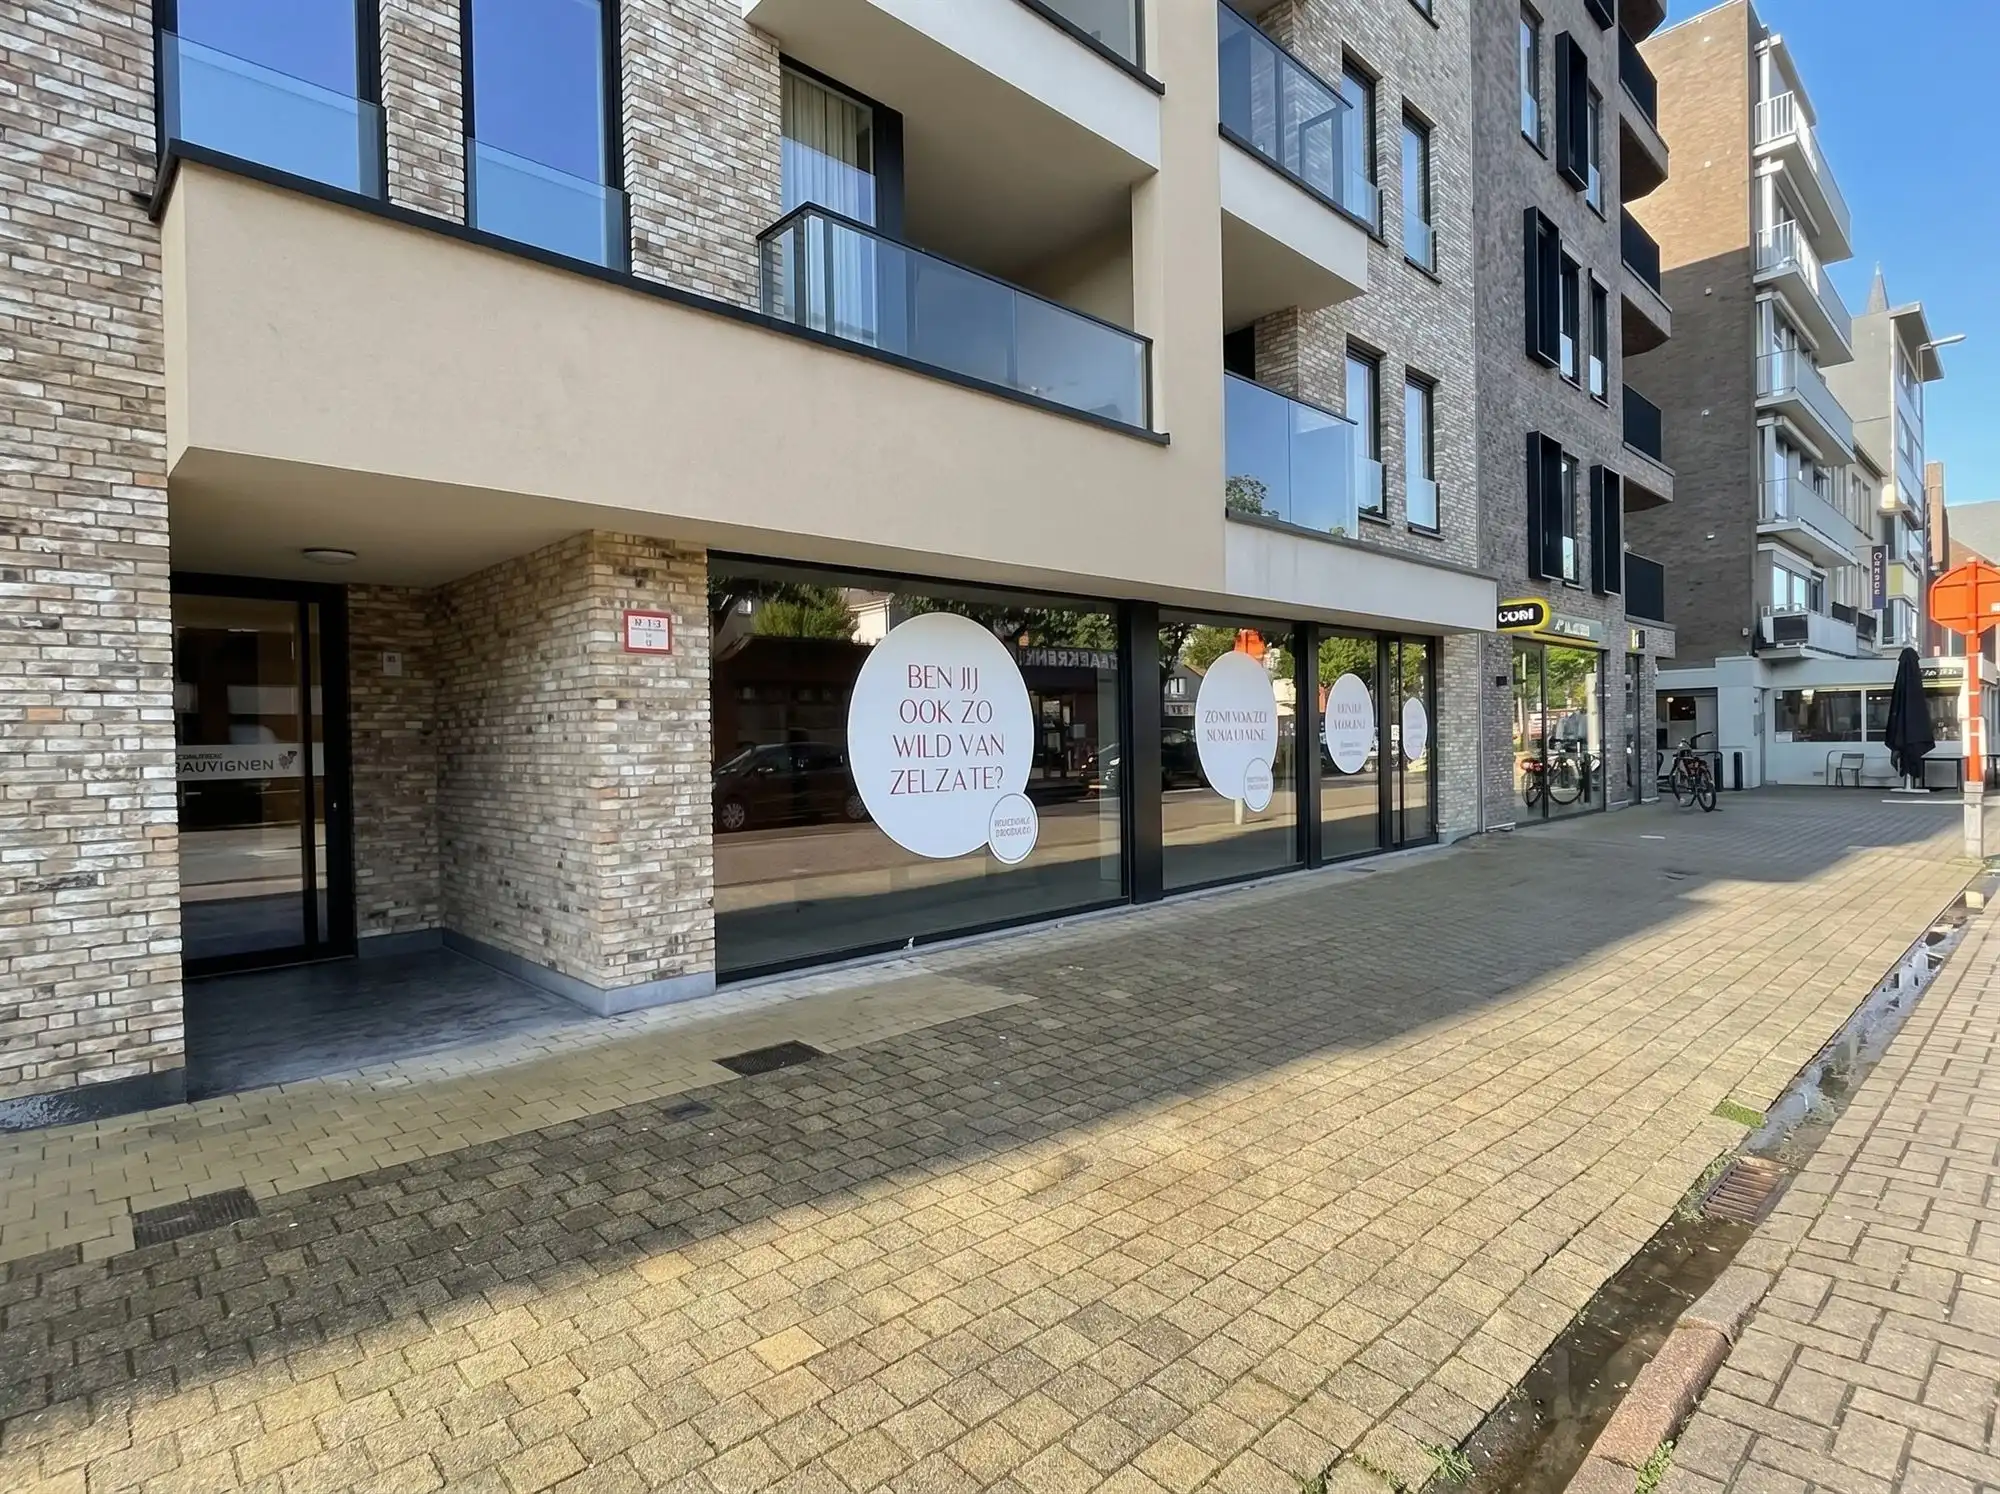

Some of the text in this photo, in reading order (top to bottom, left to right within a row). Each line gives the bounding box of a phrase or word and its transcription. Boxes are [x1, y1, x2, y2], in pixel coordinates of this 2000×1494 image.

[907, 664, 978, 694] BEN JIJ
[899, 699, 993, 724] OOK ZO
[892, 733, 1005, 758] WILD VAN
[890, 765, 1004, 795] ZELZATE?
